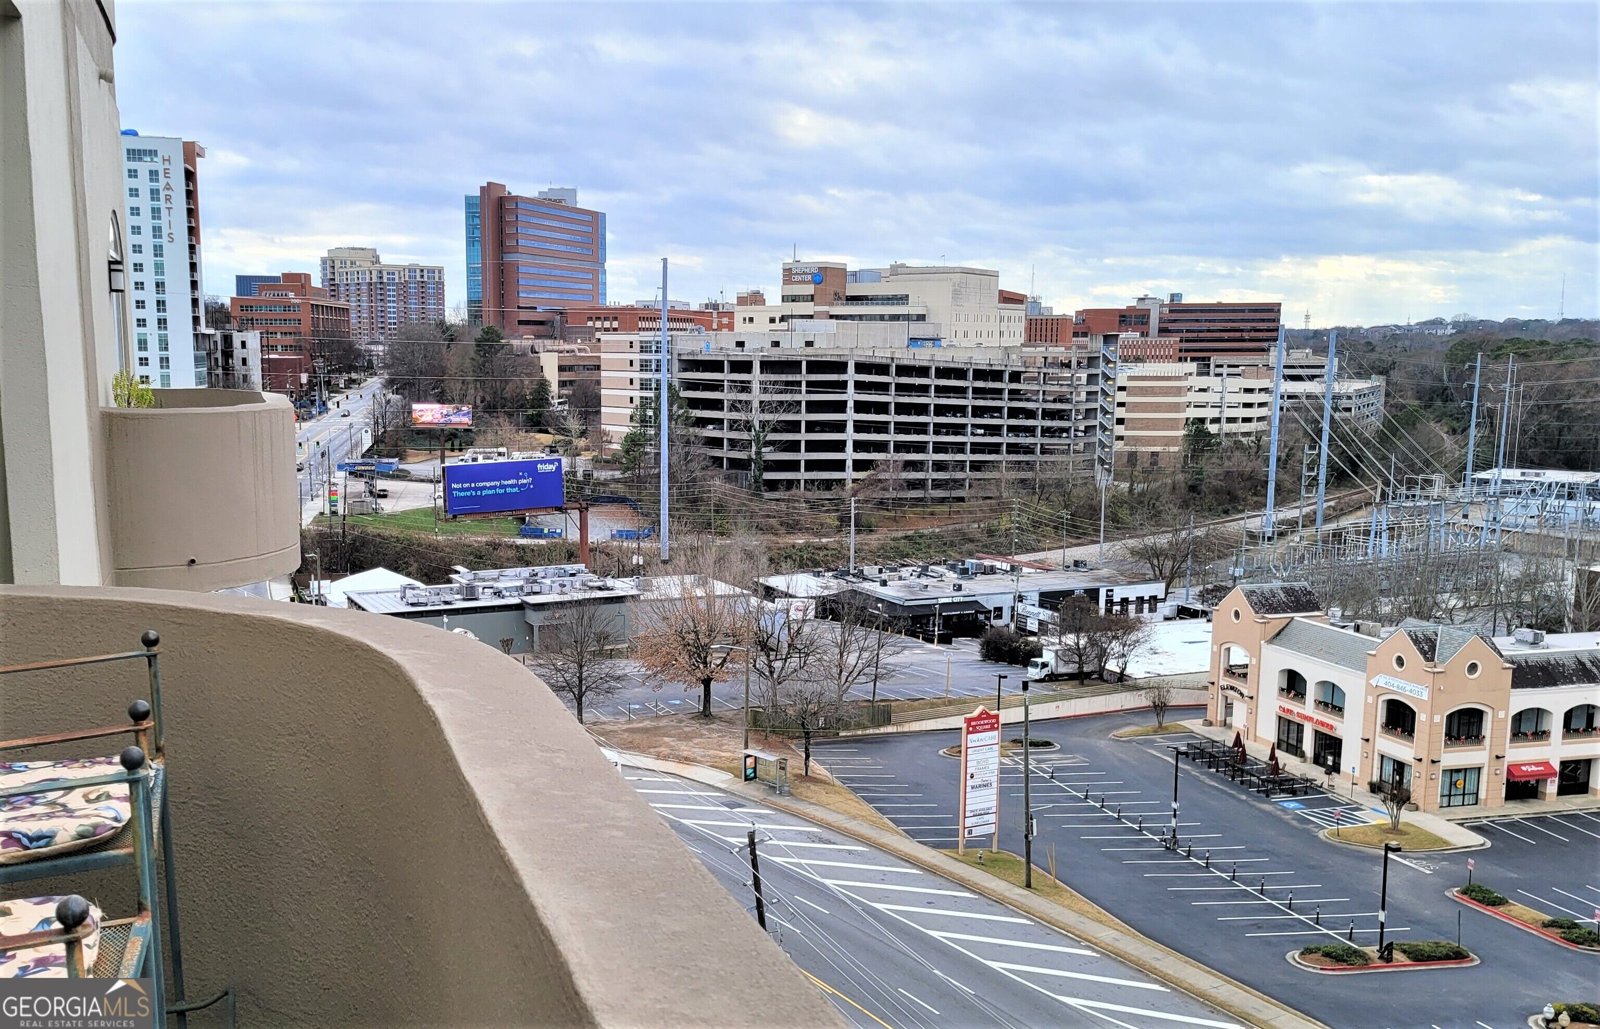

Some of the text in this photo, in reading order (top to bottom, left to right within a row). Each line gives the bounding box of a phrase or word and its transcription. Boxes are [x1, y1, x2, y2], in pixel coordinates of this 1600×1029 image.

[162, 154, 175, 244] HEARTIS
[537, 462, 557, 472] friday
[475, 480, 501, 488] company
[500, 478, 518, 486] health
[518, 477, 533, 485] plan?
[452, 489, 476, 497] There's
[481, 488, 496, 497] plan
[506, 486, 521, 494] that.
[1219, 683, 1245, 699] ELEVATOR
[1383, 680, 1424, 698] 404-846-4033
[970, 718, 997, 727] BROOKWOOD
[1278, 704, 1335, 731] CAFE SUNFLOWER
